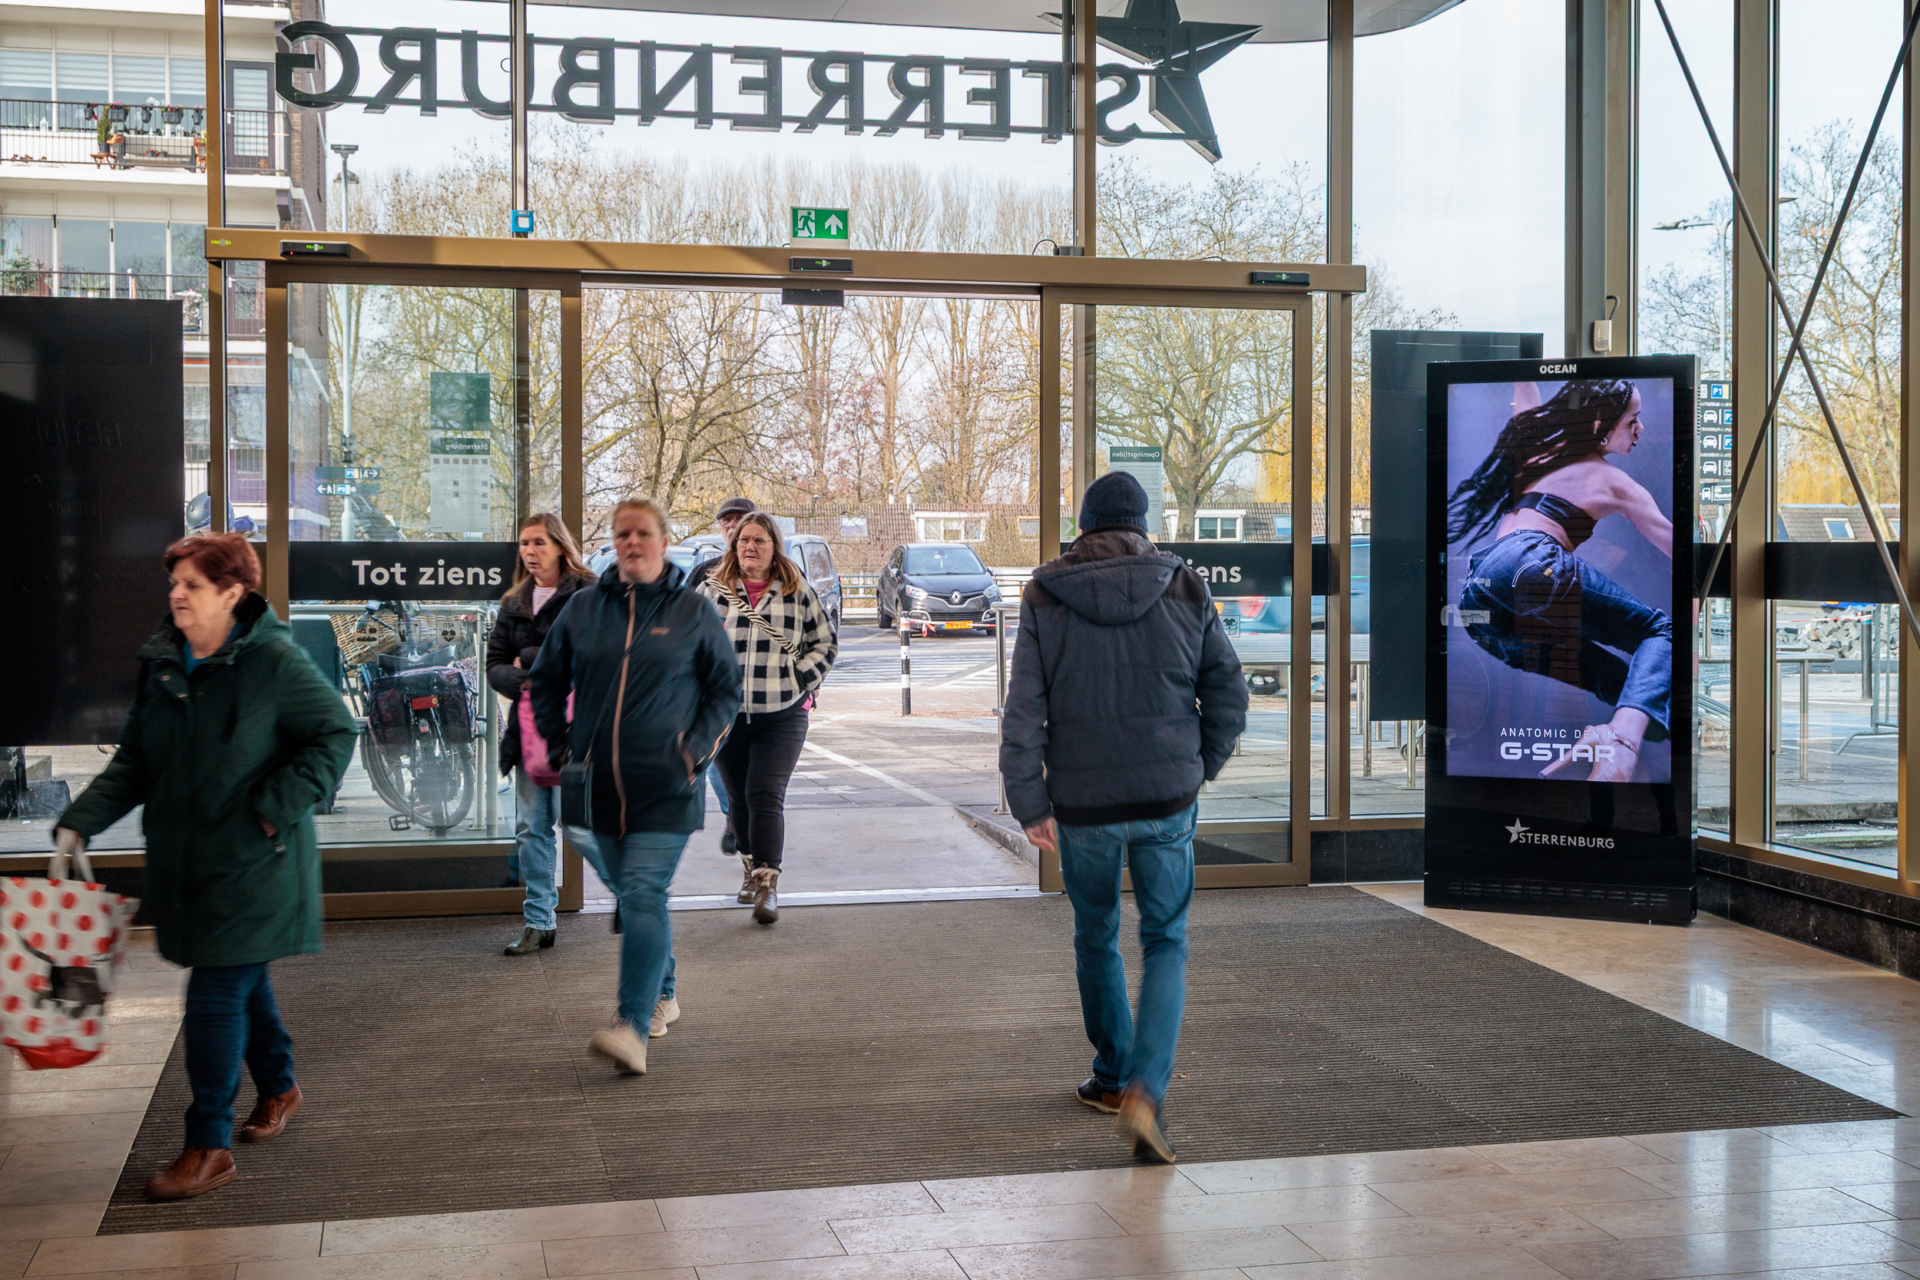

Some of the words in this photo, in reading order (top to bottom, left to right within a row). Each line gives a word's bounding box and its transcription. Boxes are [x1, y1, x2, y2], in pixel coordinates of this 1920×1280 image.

[1539, 364, 1577, 374] OCEAN
[1713, 387, 1722, 396] P1
[352, 560, 406, 585] Tot
[418, 559, 502, 585] ziens
[1500, 727, 1567, 739] ANATOMIC
[1574, 729, 1617, 740] DENIM
[1500, 741, 1616, 763] G-STAR
[1519, 832, 1615, 849] STERRENBURG
